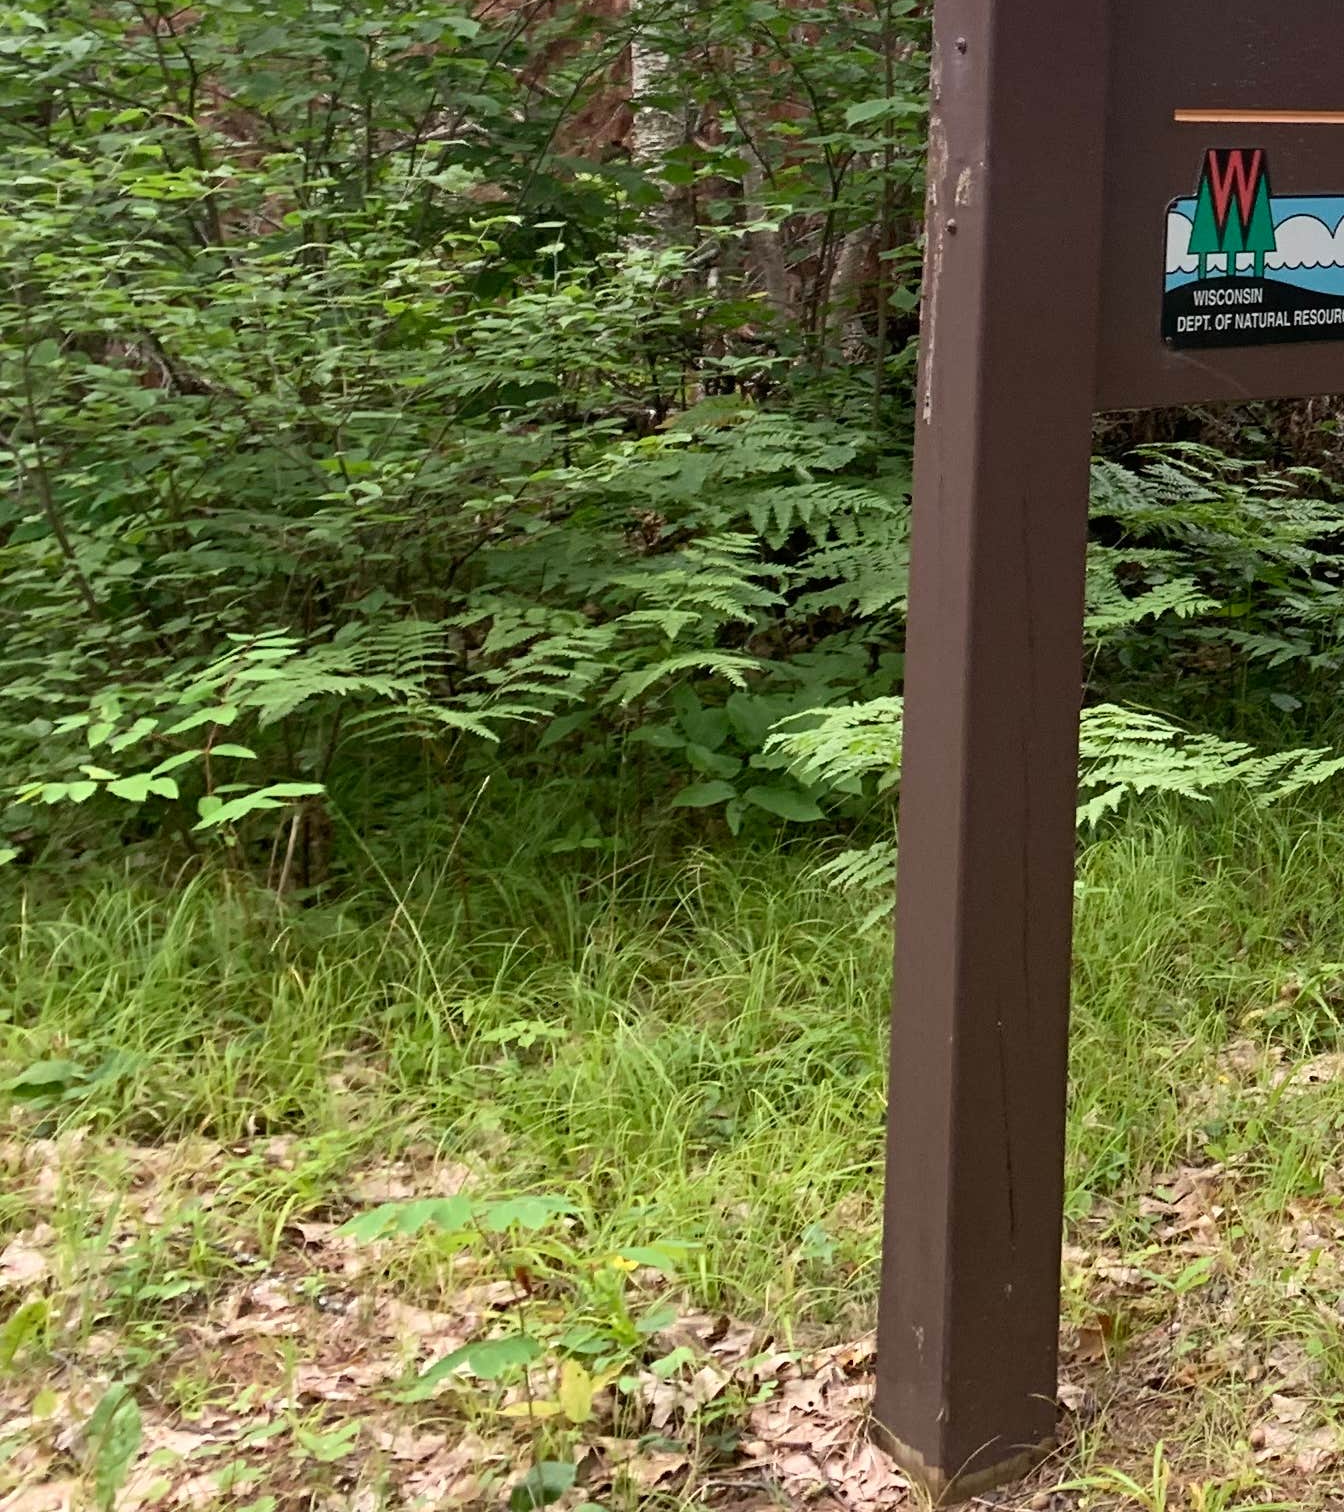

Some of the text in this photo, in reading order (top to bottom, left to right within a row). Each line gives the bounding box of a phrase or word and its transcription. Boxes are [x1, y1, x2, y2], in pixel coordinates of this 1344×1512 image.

[1193, 288, 1263, 306] WISCONSIN
[1177, 315, 1212, 333] DEPT.
[1215, 313, 1232, 330] OF
[1234, 311, 1291, 328] NATURAL
